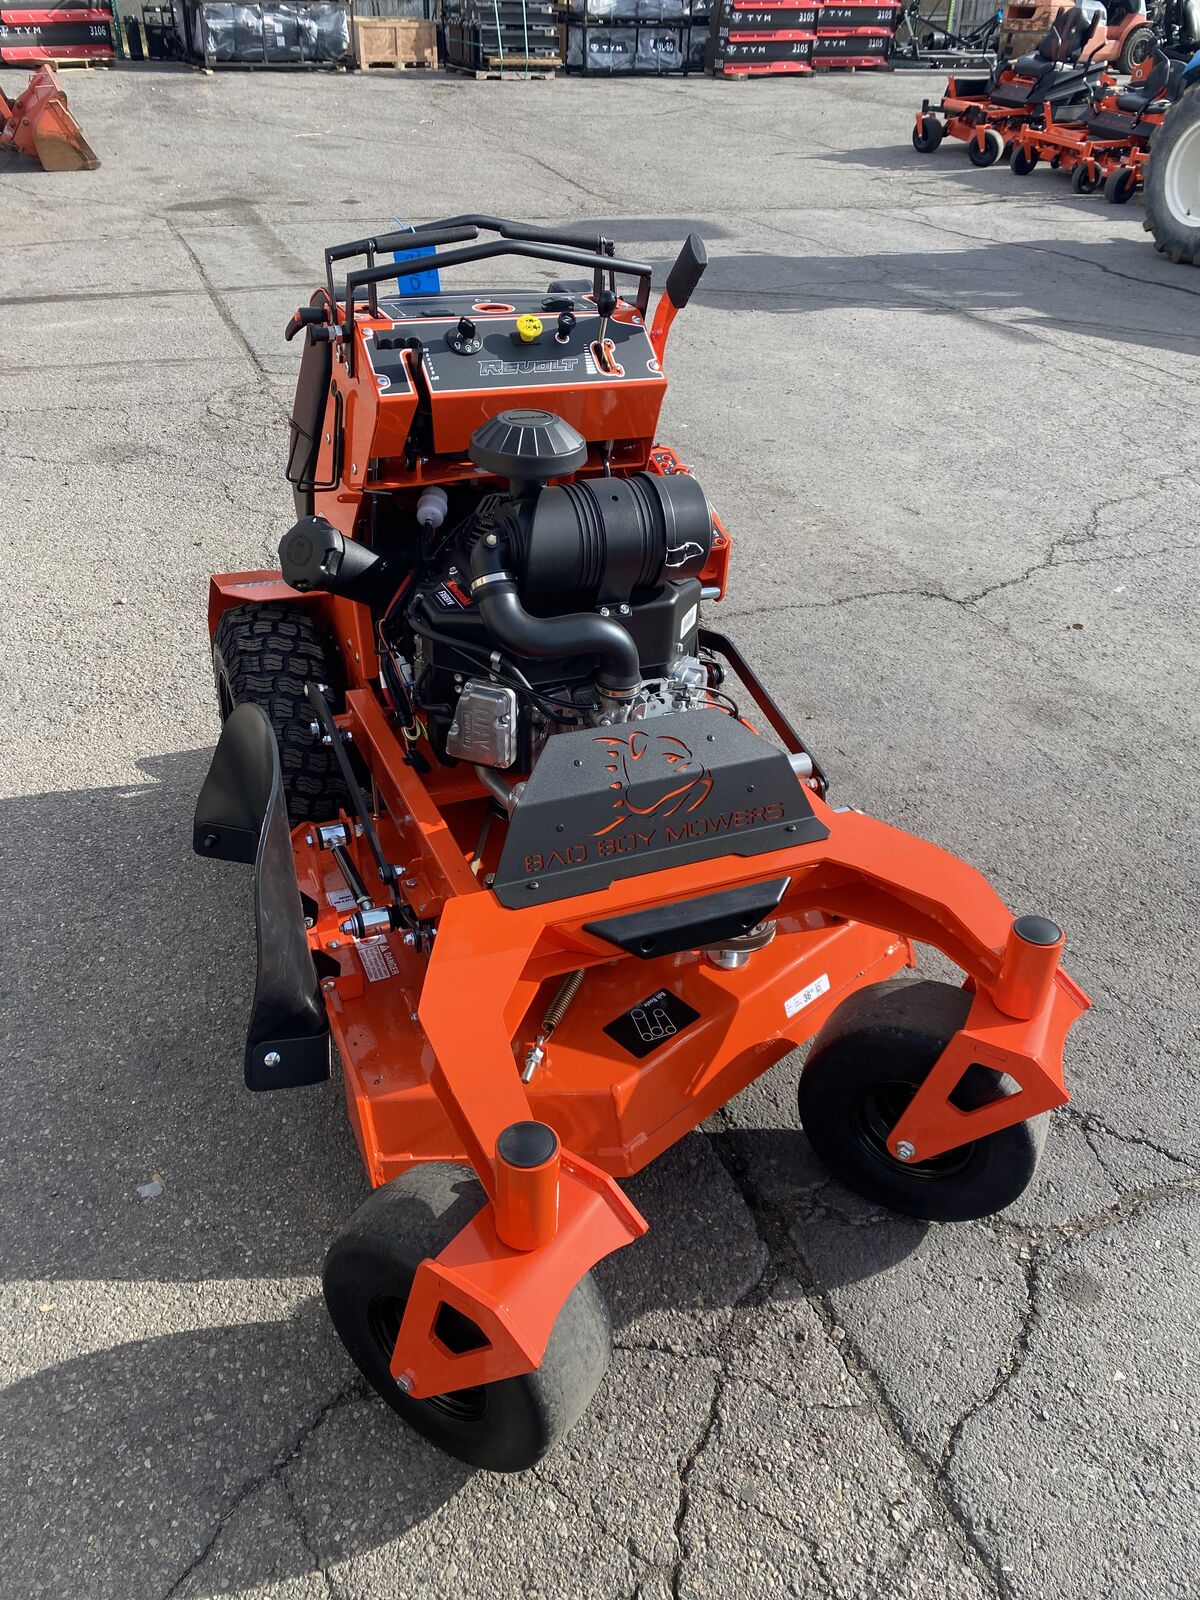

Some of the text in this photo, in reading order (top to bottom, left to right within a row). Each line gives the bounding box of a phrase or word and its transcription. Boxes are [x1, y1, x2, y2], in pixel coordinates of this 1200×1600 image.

[799, 12, 815, 22] 3105
[829, 9, 892, 20] TYM 3105
[15, 25, 106, 36] TYM 3106
[792, 43, 808, 53] 3105
[868, 39, 883, 47] 3105
[478, 358, 578, 376] REVOLT
[524, 802, 785, 873] BAD BOY MOWERS
[383, 951, 400, 976] DANGER
